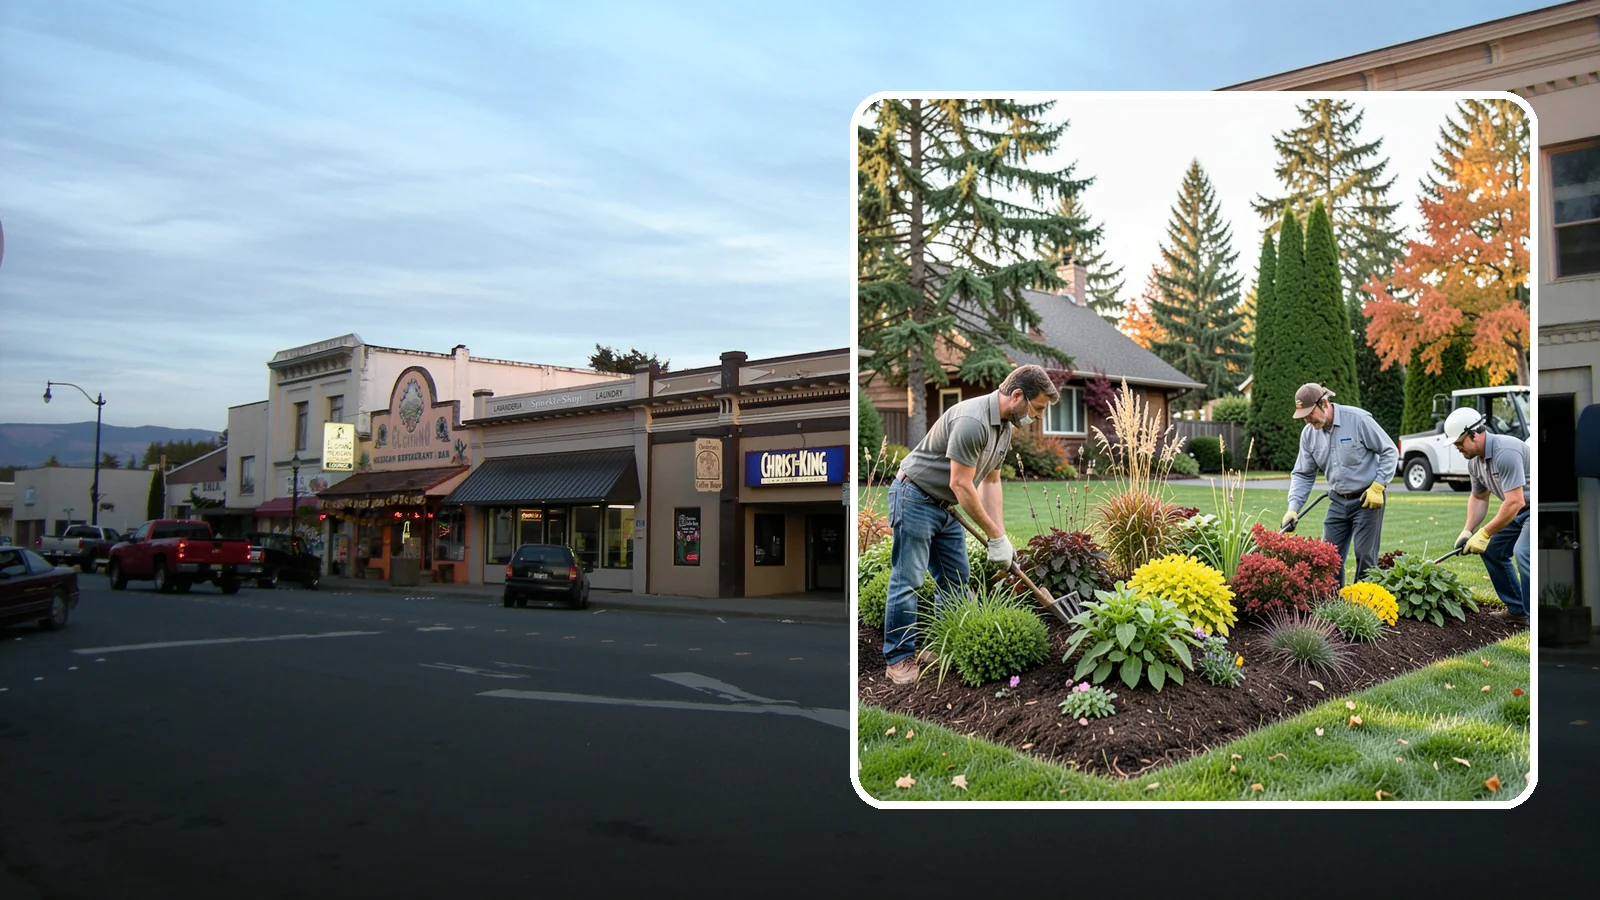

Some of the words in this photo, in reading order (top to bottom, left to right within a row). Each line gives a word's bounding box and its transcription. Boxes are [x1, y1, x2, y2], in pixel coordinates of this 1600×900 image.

[595, 389, 624, 400] LAUNDRY
[493, 402, 523, 412] LAVANDERIA
[373, 454, 396, 464] MEXICAN
[397, 451, 434, 462] RESTAURANT
[437, 450, 450, 459] BAR
[761, 452, 797, 478] CHRIST
[799, 450, 827, 476] KING
